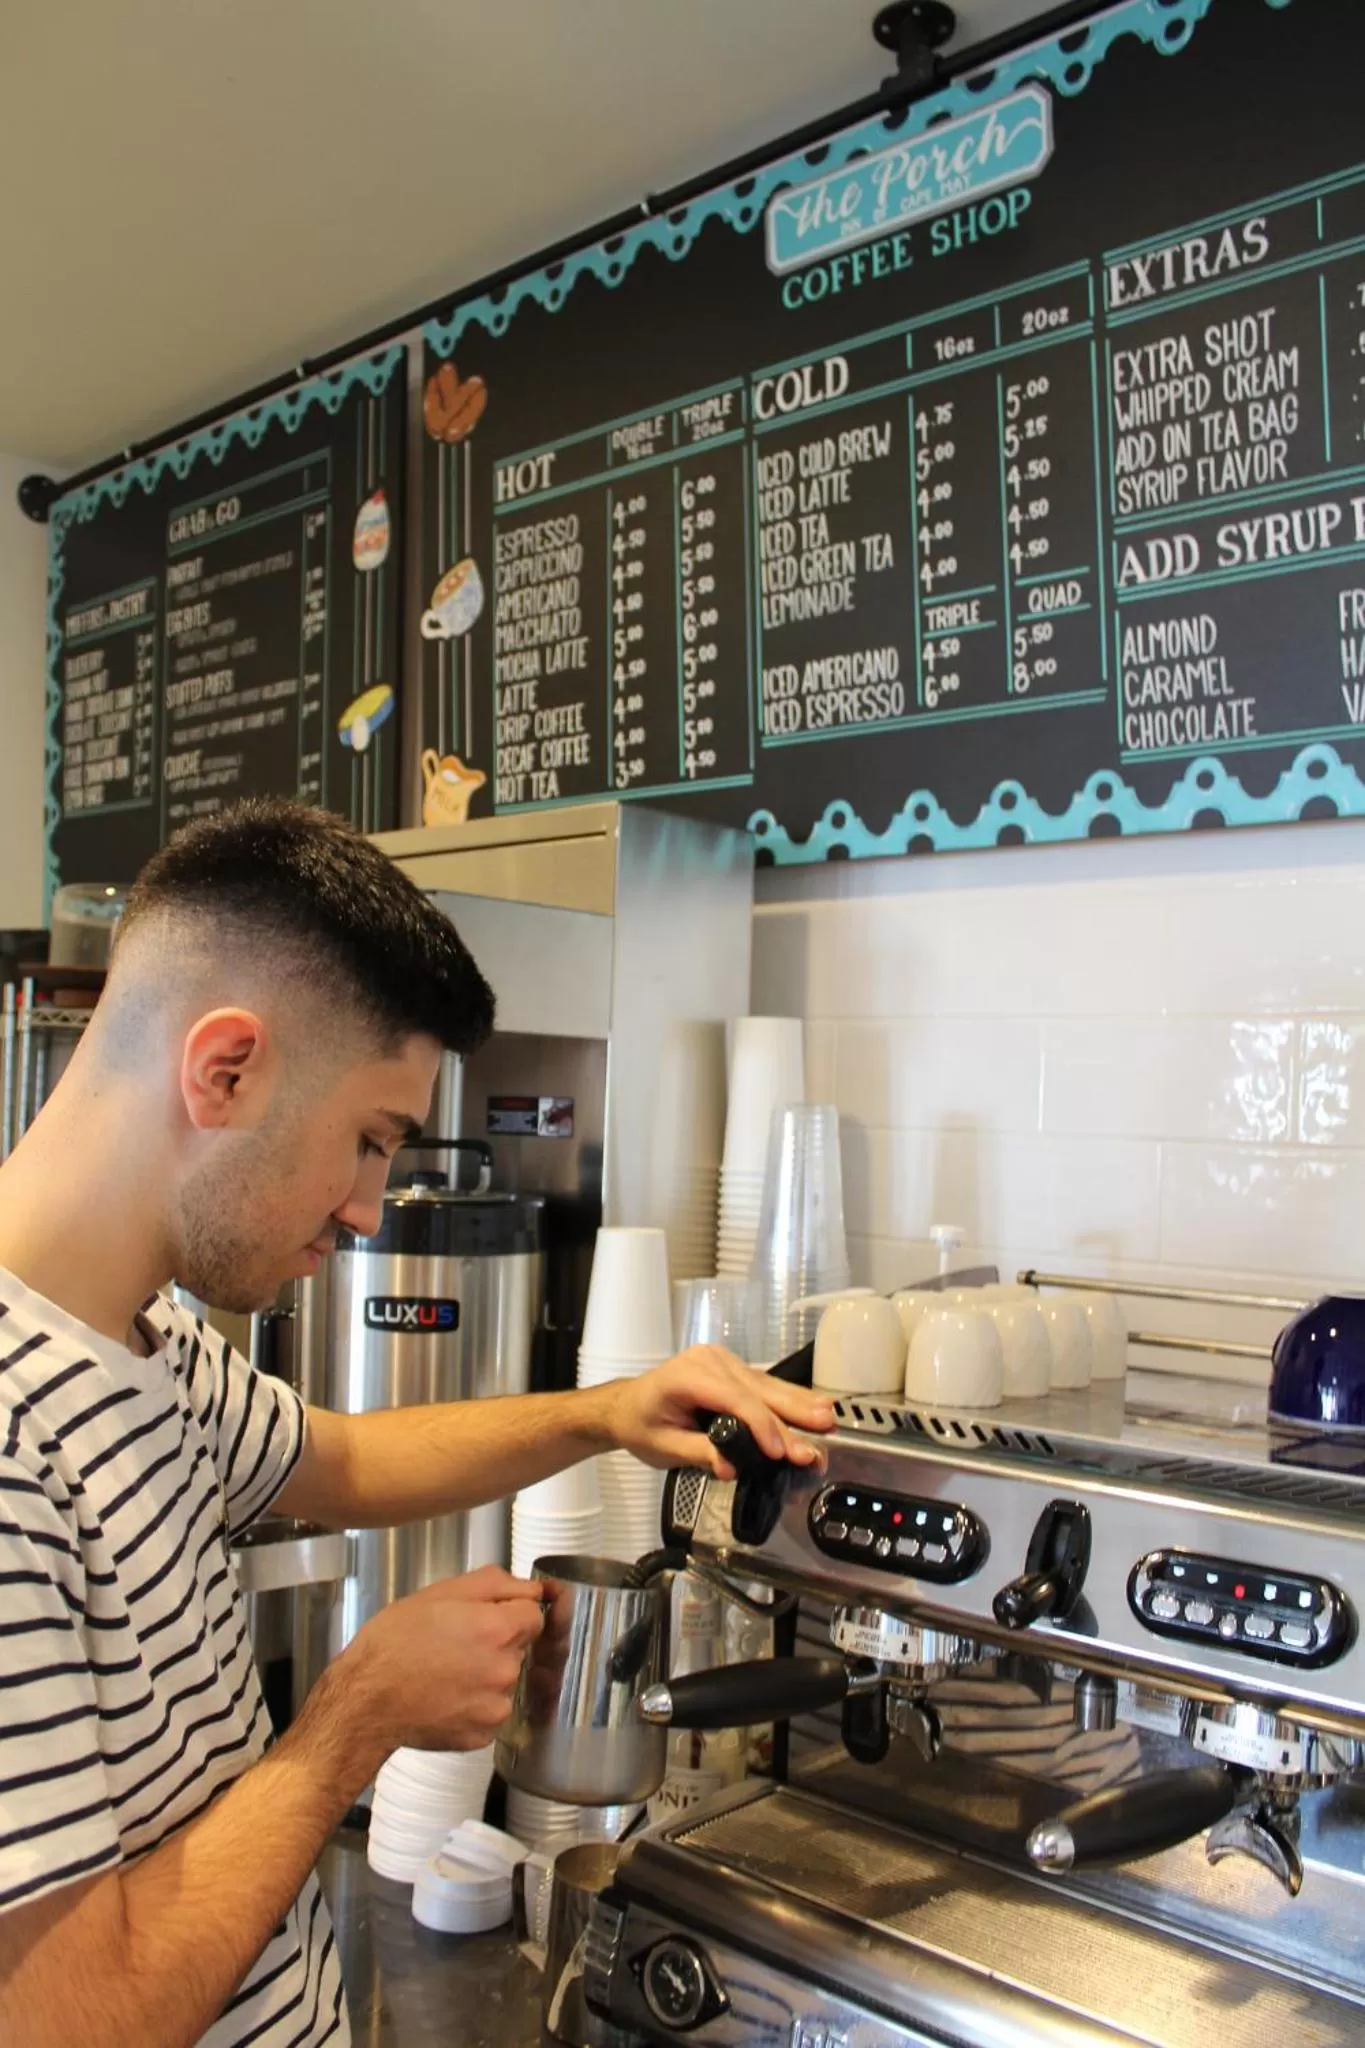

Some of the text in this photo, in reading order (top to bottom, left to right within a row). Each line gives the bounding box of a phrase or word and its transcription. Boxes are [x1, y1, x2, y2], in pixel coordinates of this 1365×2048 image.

[871, 109, 1043, 212] Porch
[781, 188, 1031, 310] COFFEE SHOP
[1108, 216, 1270, 309] EXTRAS
[1113, 307, 1276, 393] EXTRA SHOT
[681, 392, 734, 427] TRIPLE
[755, 355, 849, 420] COLD
[1006, 376, 1049, 420] 5.00
[1115, 371, 1211, 432] WHIPPED
[1222, 347, 1299, 403] CREAM
[757, 420, 892, 490] ICED COLD BREW
[1115, 392, 1298, 475] ADD ON TEA BAG
[496, 451, 557, 502] HOT
[916, 442, 954, 482] 5.00
[1007, 457, 1050, 498] 4.50
[1117, 439, 1288, 514] SYRUP FLAVOR
[216, 496, 241, 525] GO
[758, 468, 852, 522] ICED LATTE
[1008, 498, 1049, 536] 4.50
[496, 514, 579, 563] ESPRESSO
[760, 513, 830, 560] ICED TEA
[1010, 538, 1049, 575] 4.50
[1117, 533, 1200, 588] ADD
[1215, 502, 1343, 569] SYRUP
[495, 543, 583, 593] CAPPUCCINO
[761, 533, 894, 594] ICED GREEN TEA
[921, 557, 957, 592] 4.00
[495, 576, 579, 624] AMERICANO
[762, 577, 856, 630] LEMONADE
[925, 600, 981, 631] TRIPLE
[1028, 580, 1082, 613] QUAD
[495, 607, 582, 653] MACCHIATO
[1013, 622, 1053, 658] 5.50
[1122, 614, 1218, 666] ALMOND
[495, 637, 589, 683] MOCHA LATTE
[762, 647, 899, 701] ICED AMERICANO
[922, 638, 960, 673] 4.50
[1013, 658, 1057, 694] 8.00
[495, 680, 538, 716] LATTE
[1124, 657, 1235, 709] CARAMEL
[496, 702, 586, 747] DRIP COFFEE
[763, 681, 905, 735] ICED ESPRESSO
[1124, 698, 1257, 750] CHOCOLATE
[496, 733, 591, 776] DECAF COFFEE
[496, 770, 560, 802] HOT TEA
[368, 1301, 454, 1324] LUXUS
